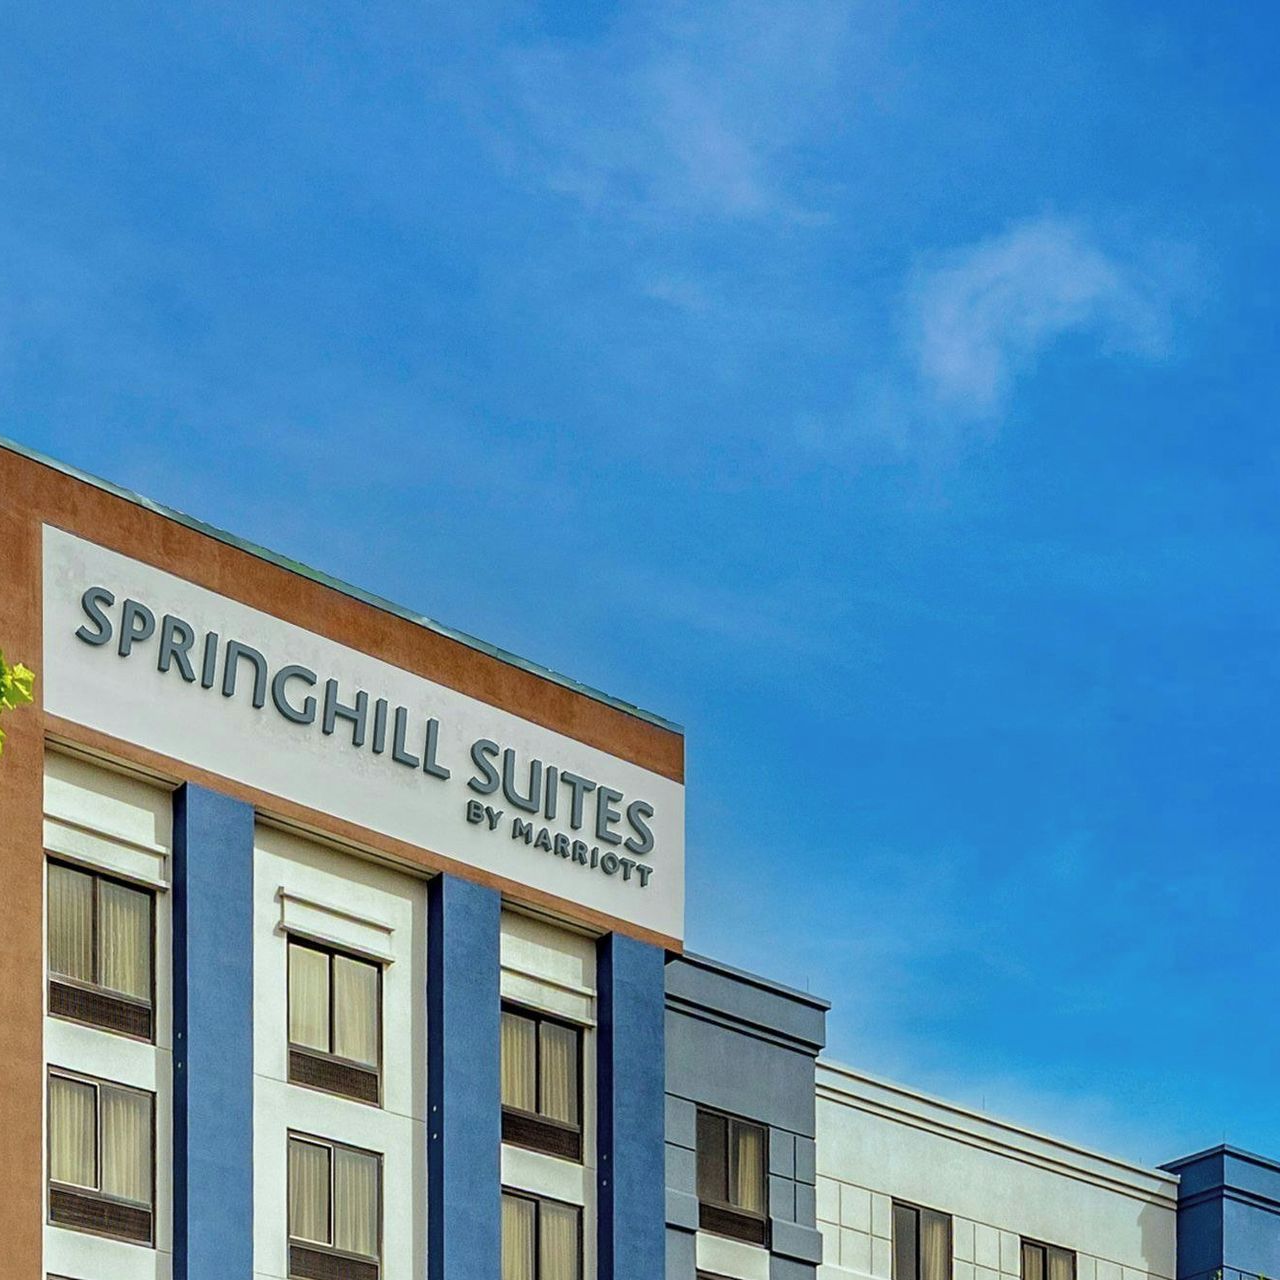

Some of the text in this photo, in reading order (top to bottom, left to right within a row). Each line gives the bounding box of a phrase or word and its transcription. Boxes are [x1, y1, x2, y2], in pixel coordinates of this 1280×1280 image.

[75, 586, 655, 854] SPRINGHILL SUITES
[466, 799, 654, 888] BY MARRIOTT
